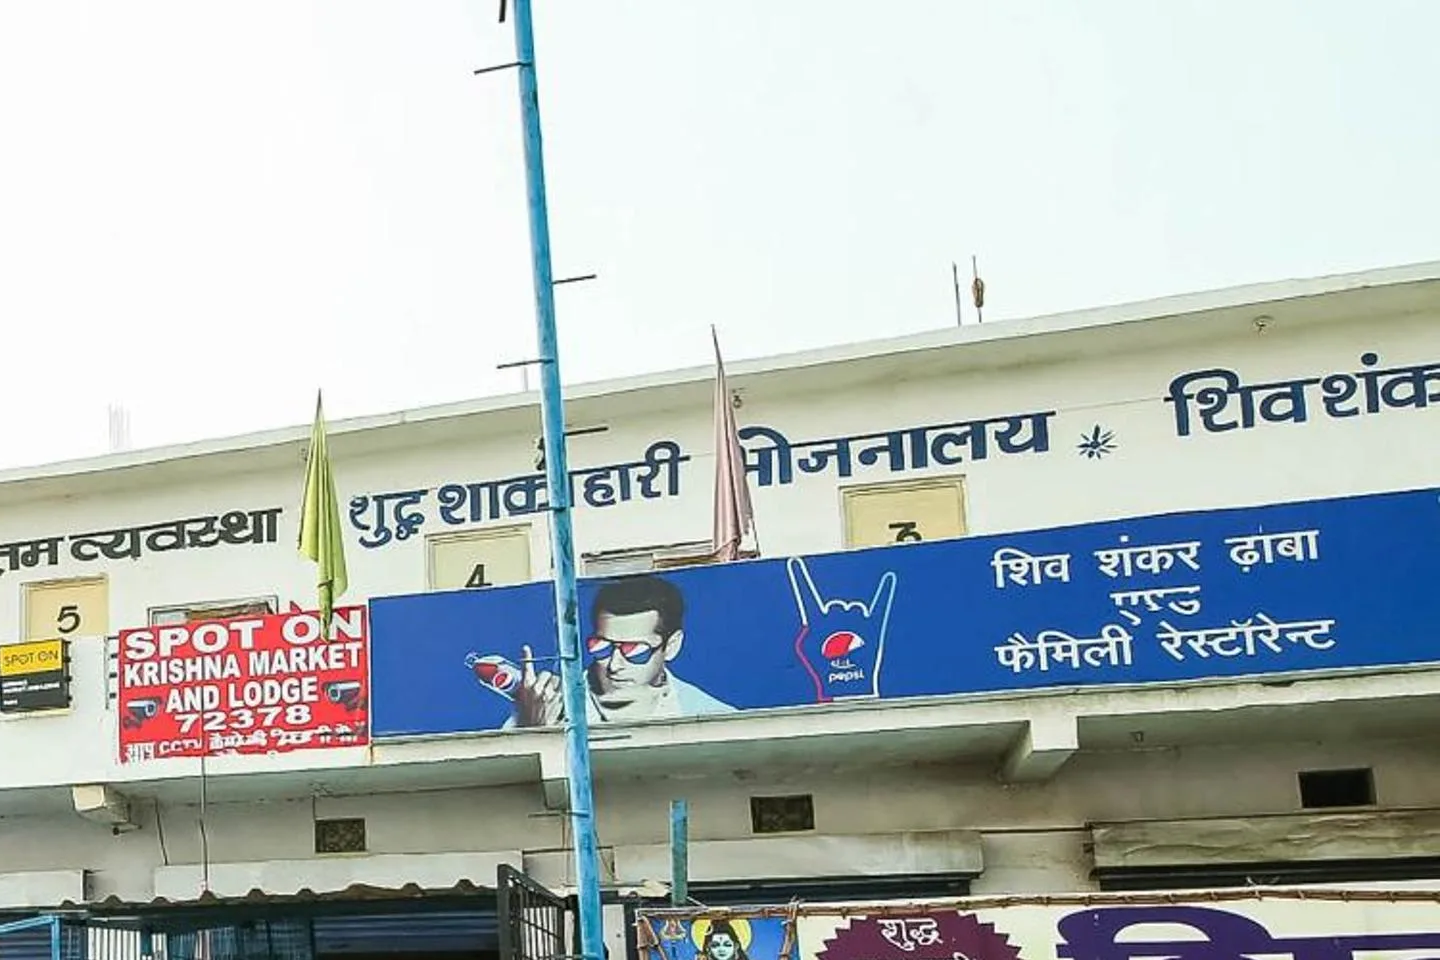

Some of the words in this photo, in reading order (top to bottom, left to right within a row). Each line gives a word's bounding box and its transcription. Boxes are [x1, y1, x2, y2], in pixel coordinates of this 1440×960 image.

[1163, 369, 1320, 436] शिव
[69, 508, 282, 560] व्यवस्था
[349, 489, 429, 549] शुद्ध
[465, 564, 492, 588] 4
[991, 548, 1071, 588] शिव
[1095, 535, 1201, 577] शंकर
[57, 606, 81, 633] 5
[124, 619, 264, 661] SPOT
[281, 609, 362, 646] ON
[3, 653, 35, 667] SPOT
[38, 649, 59, 663] ON
[124, 654, 240, 688] KRISHNA
[249, 641, 363, 677] MARKET
[994, 625, 1134, 673] फैमिली
[166, 685, 220, 713] AND
[229, 677, 319, 708] LODGE
[174, 704, 312, 733] 72378
[877, 918, 943, 950] शुद्ध
